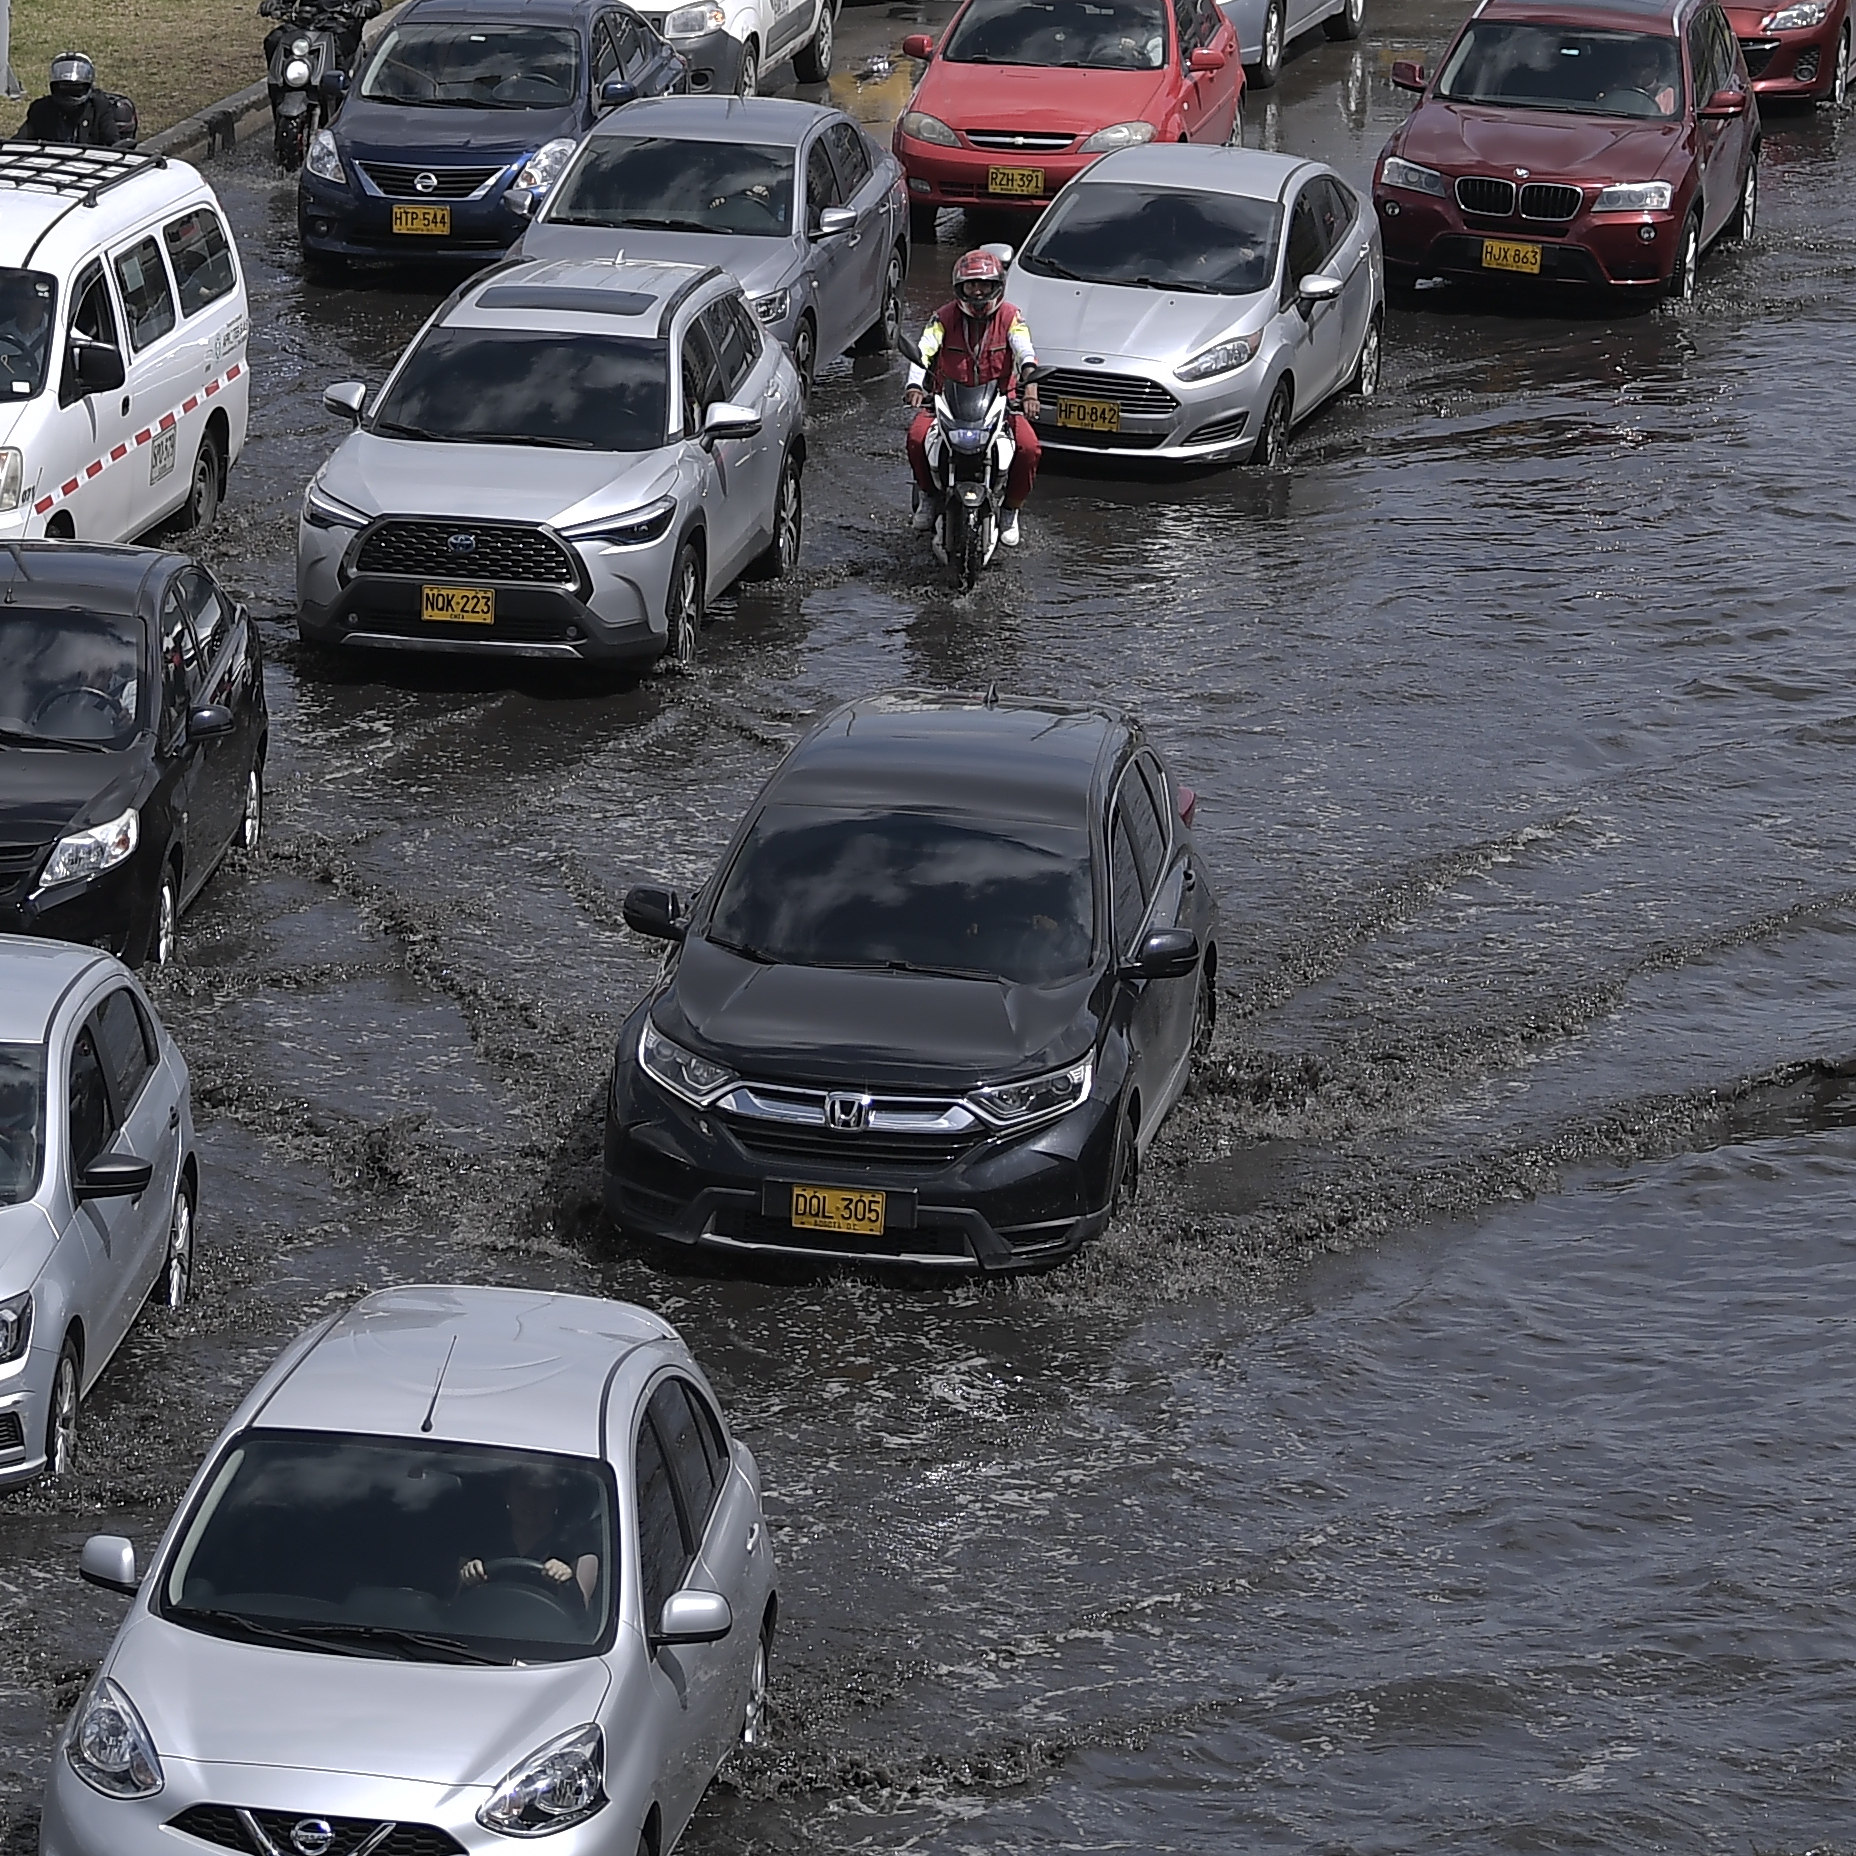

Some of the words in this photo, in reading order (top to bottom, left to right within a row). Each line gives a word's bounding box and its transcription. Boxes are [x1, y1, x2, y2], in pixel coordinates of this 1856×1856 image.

[990, 171, 1014, 187] RZH
[1017, 173, 1040, 189] 391
[394, 210, 419, 227] HTP
[422, 211, 448, 228] 544
[1484, 244, 1511, 262] HJX
[1513, 248, 1539, 266] 863
[1058, 402, 1087, 421] HFO
[1089, 406, 1117, 424] 842
[425, 592, 456, 613] NQK
[460, 594, 491, 615] 223
[795, 1193, 834, 1219] DQL
[840, 1196, 881, 1223] 305
